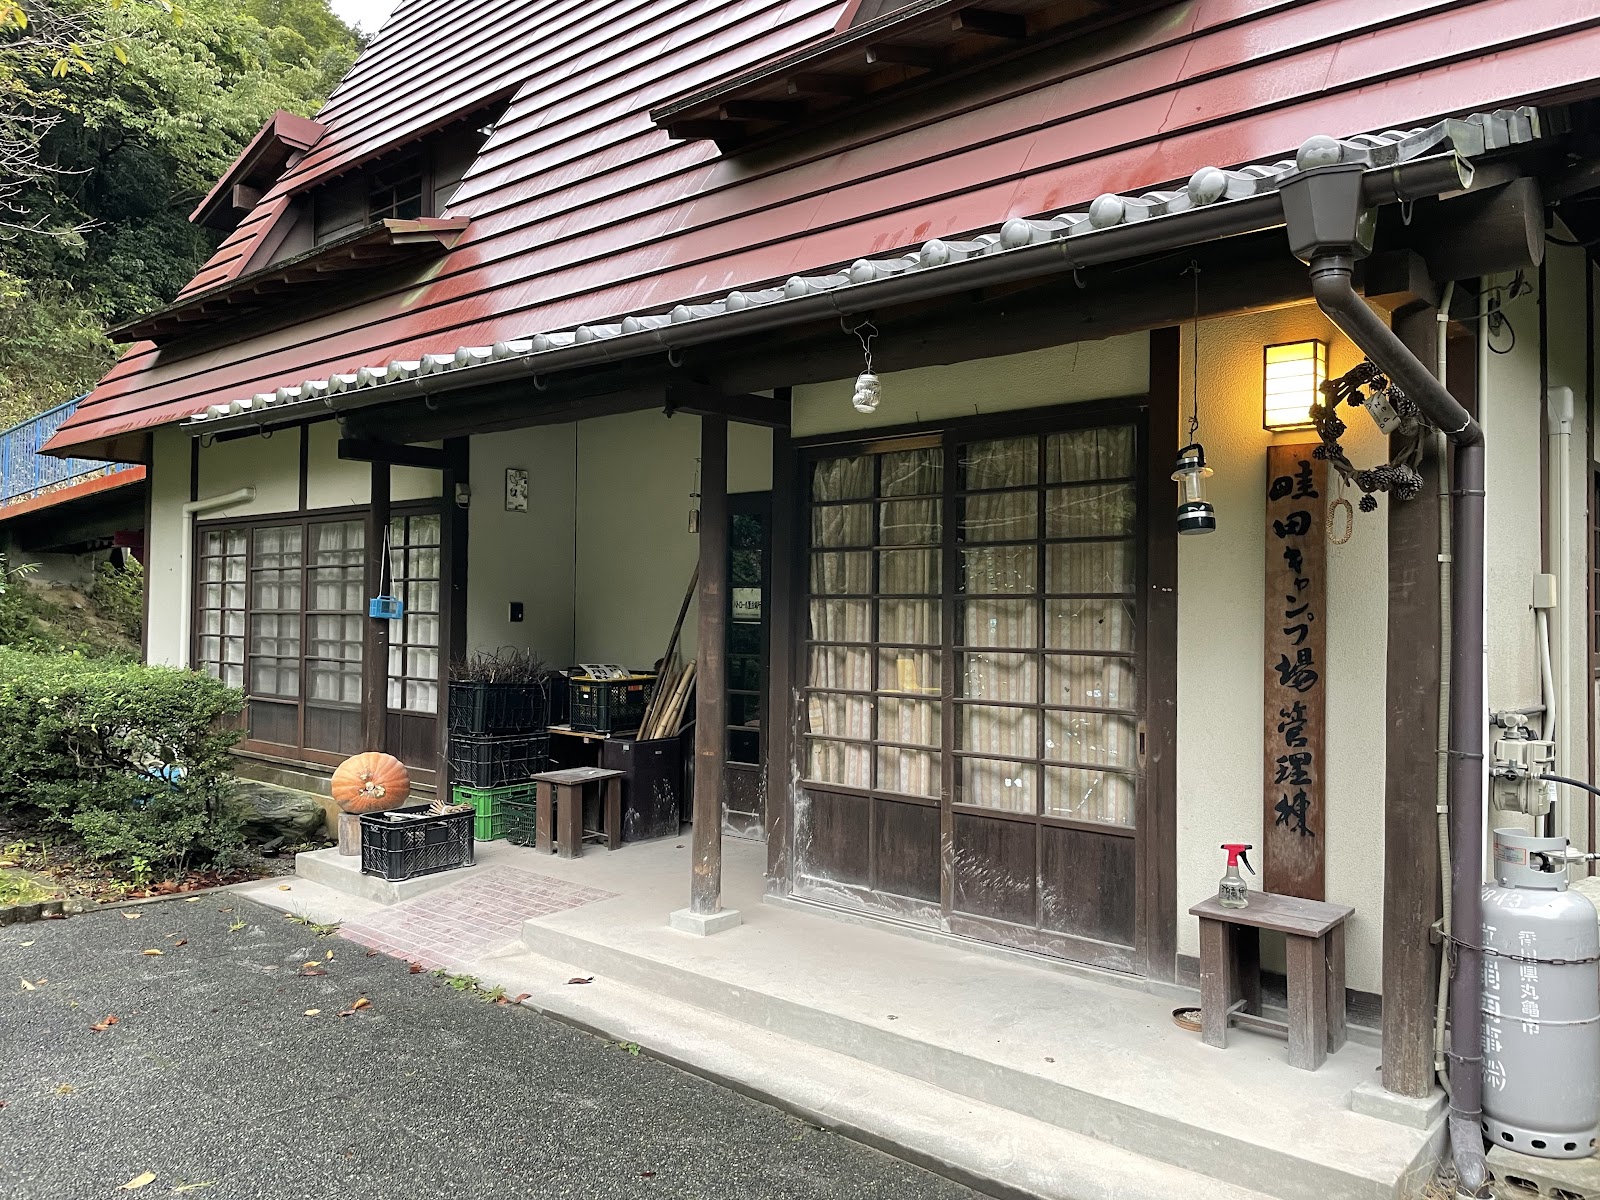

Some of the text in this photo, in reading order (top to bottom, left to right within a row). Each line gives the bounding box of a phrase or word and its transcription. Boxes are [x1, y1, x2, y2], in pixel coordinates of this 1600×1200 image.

[1269, 459, 1320, 838] 畦田キャンプ場管理棟
